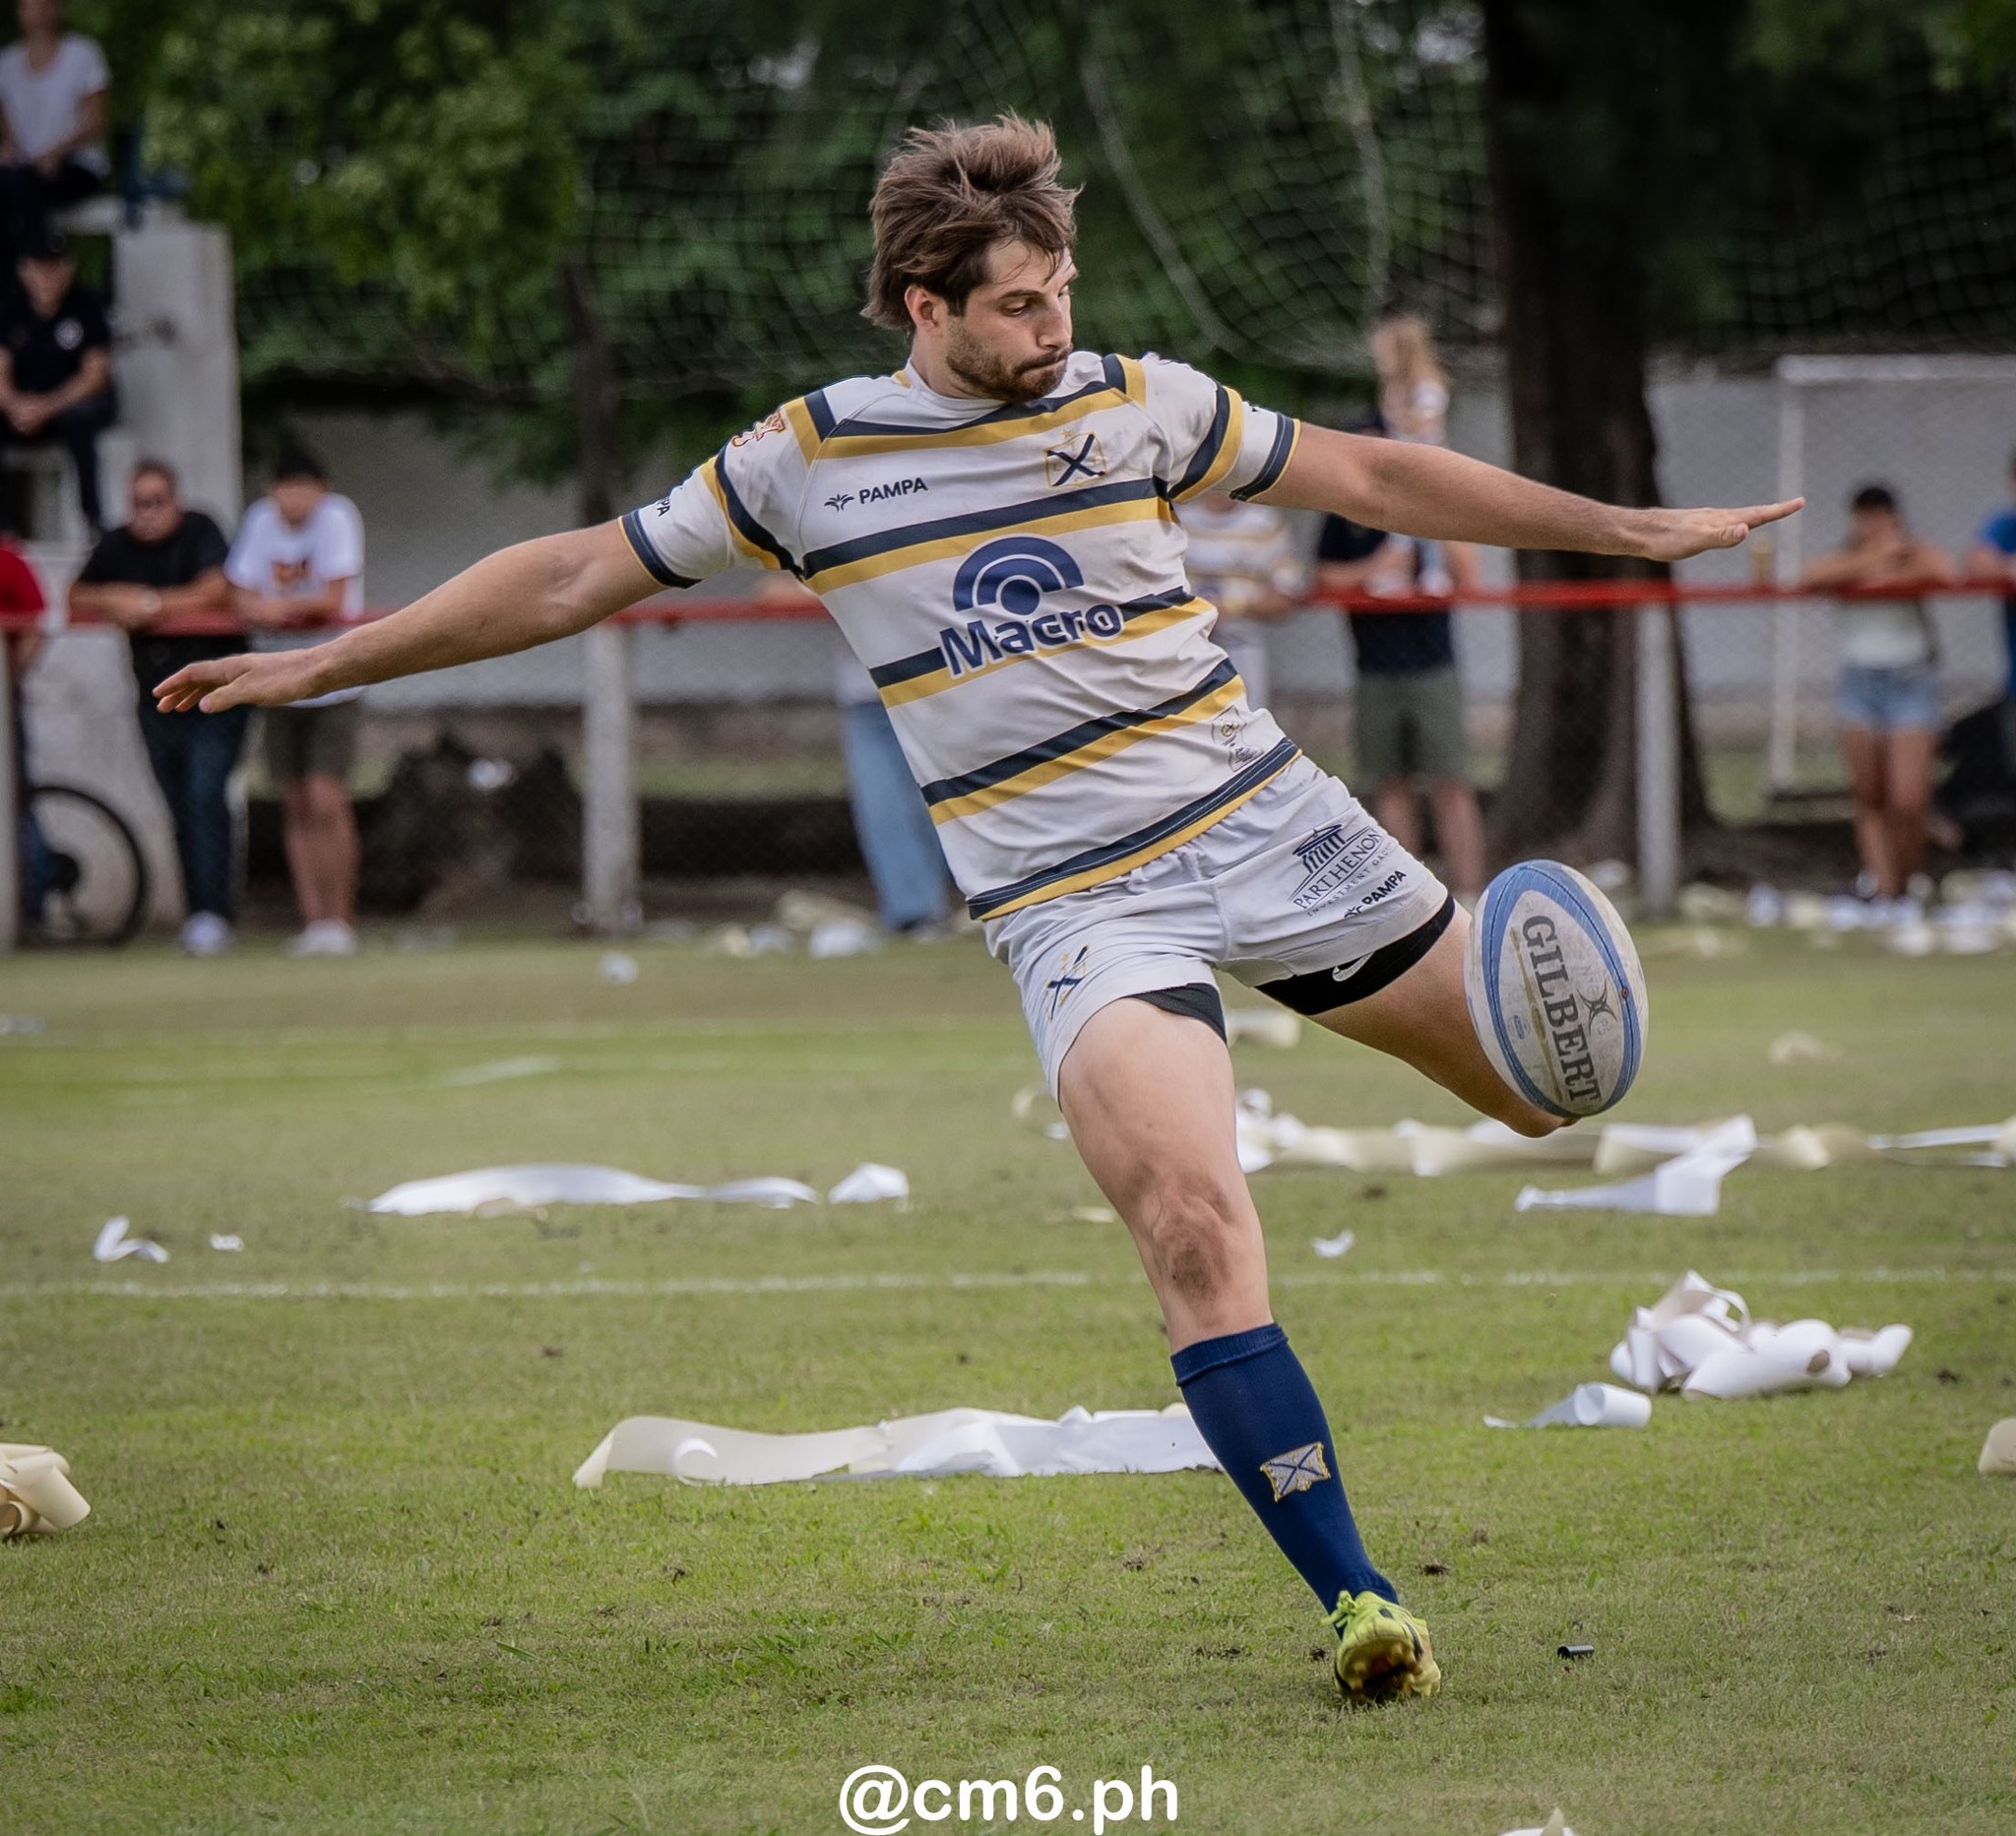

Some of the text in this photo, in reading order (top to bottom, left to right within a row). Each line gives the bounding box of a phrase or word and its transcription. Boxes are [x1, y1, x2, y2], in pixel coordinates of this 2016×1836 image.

[858, 477, 928, 504] PAMPA
[938, 602, 1124, 677] Macro
[1292, 828, 1383, 910] PARTHENON
[1361, 870, 1407, 905] PAMPA
[1522, 915, 1603, 1103] GILBERT
